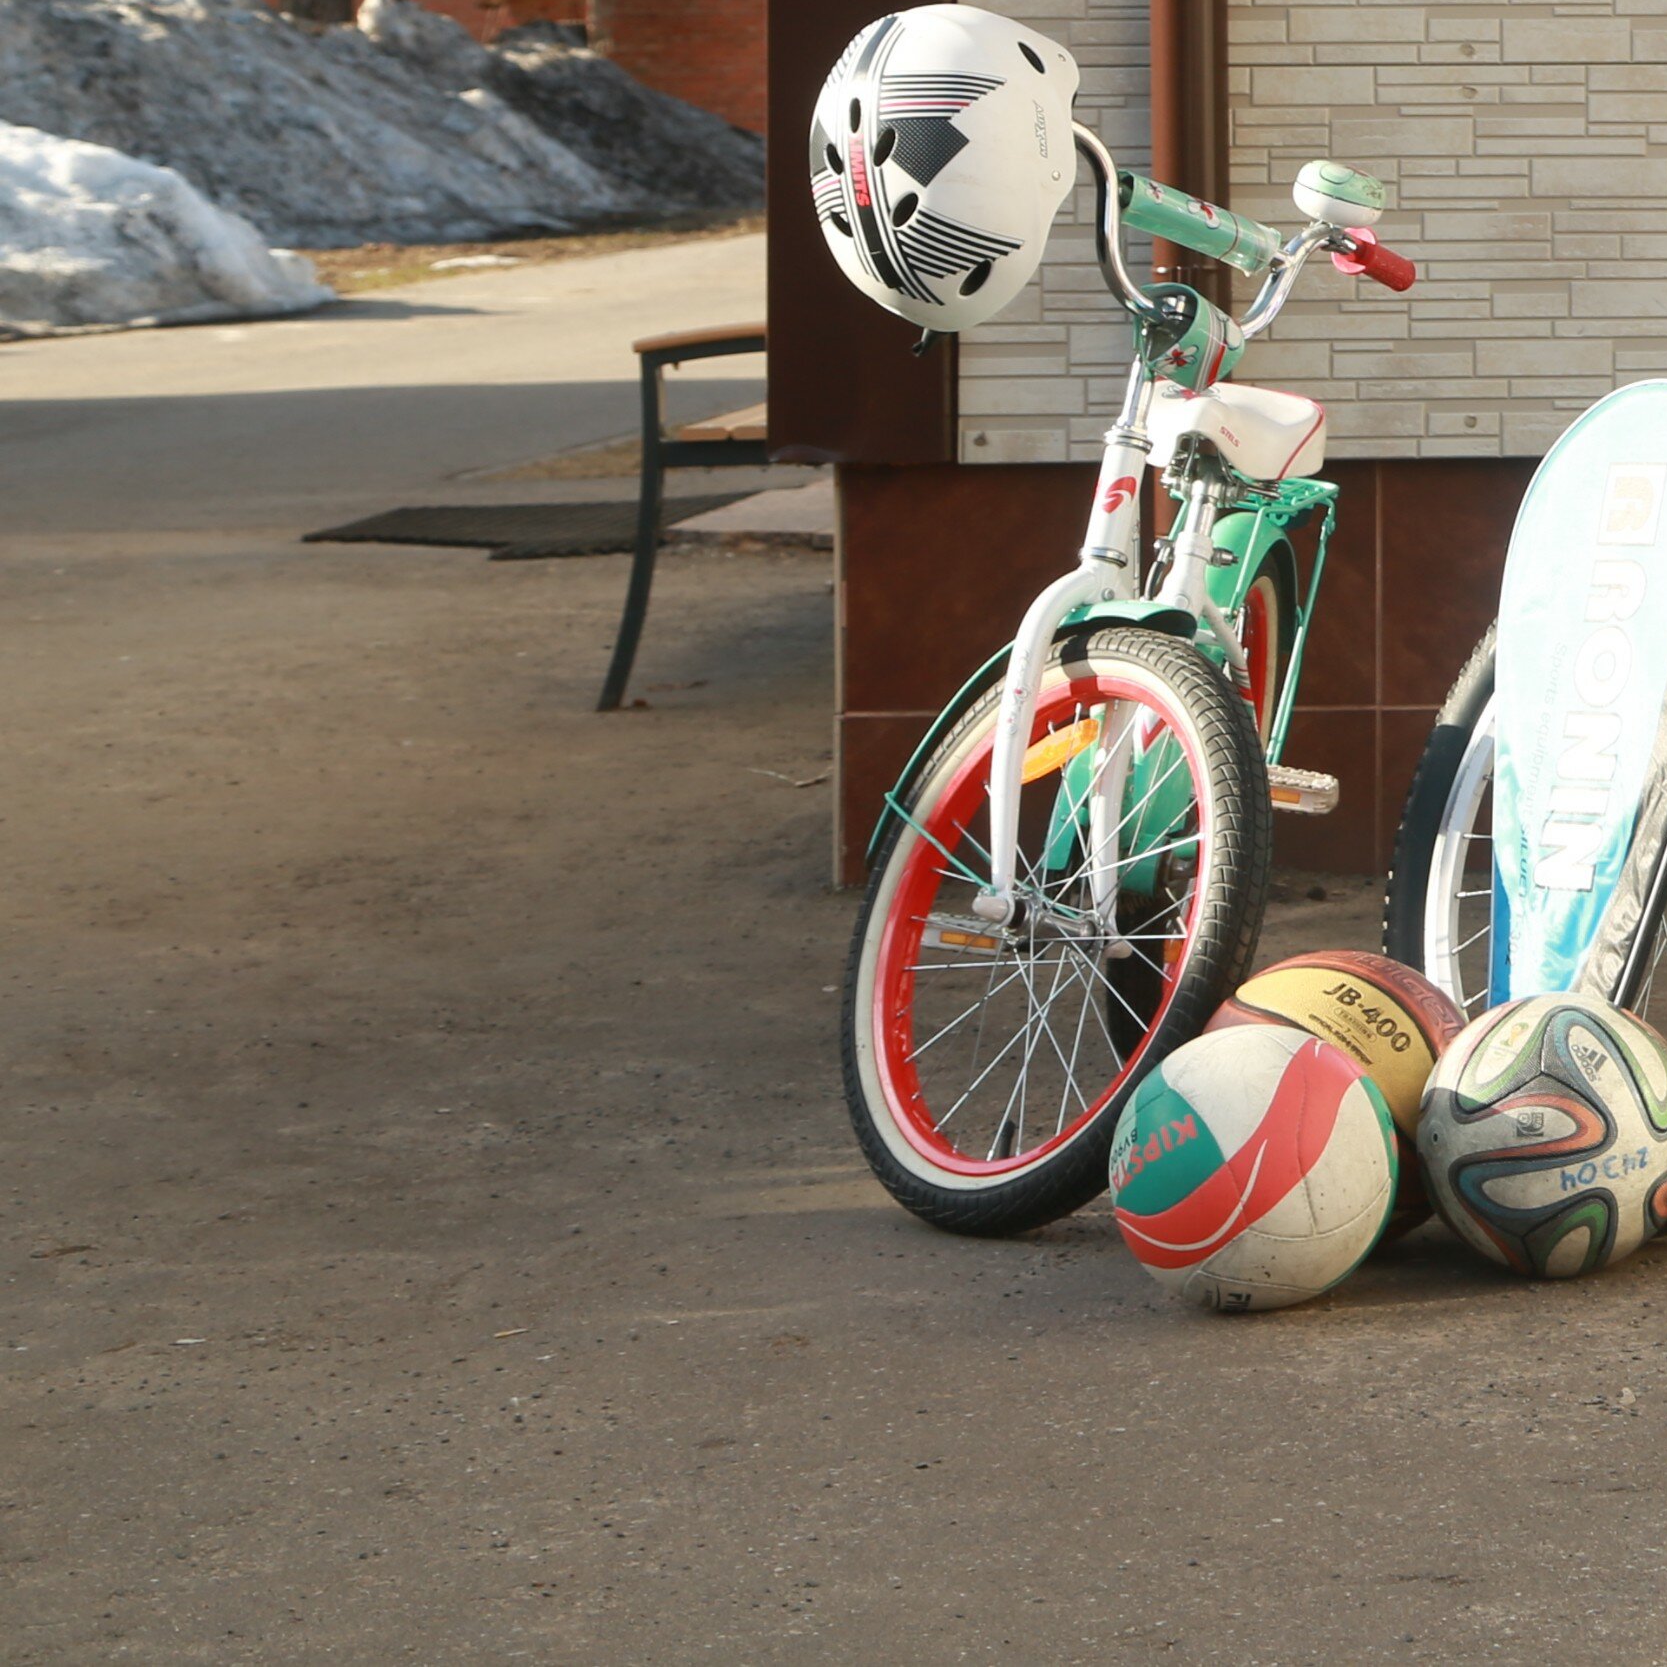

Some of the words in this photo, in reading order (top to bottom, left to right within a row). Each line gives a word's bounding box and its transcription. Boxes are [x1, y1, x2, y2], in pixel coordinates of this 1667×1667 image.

[1219, 425, 1240, 448] STELS
[1535, 560, 1648, 893] RONIN
[1322, 982, 1412, 1053] JB-400
[1570, 1044, 1598, 1082] adidas
[1112, 1113, 1199, 1193] KIPSTA
